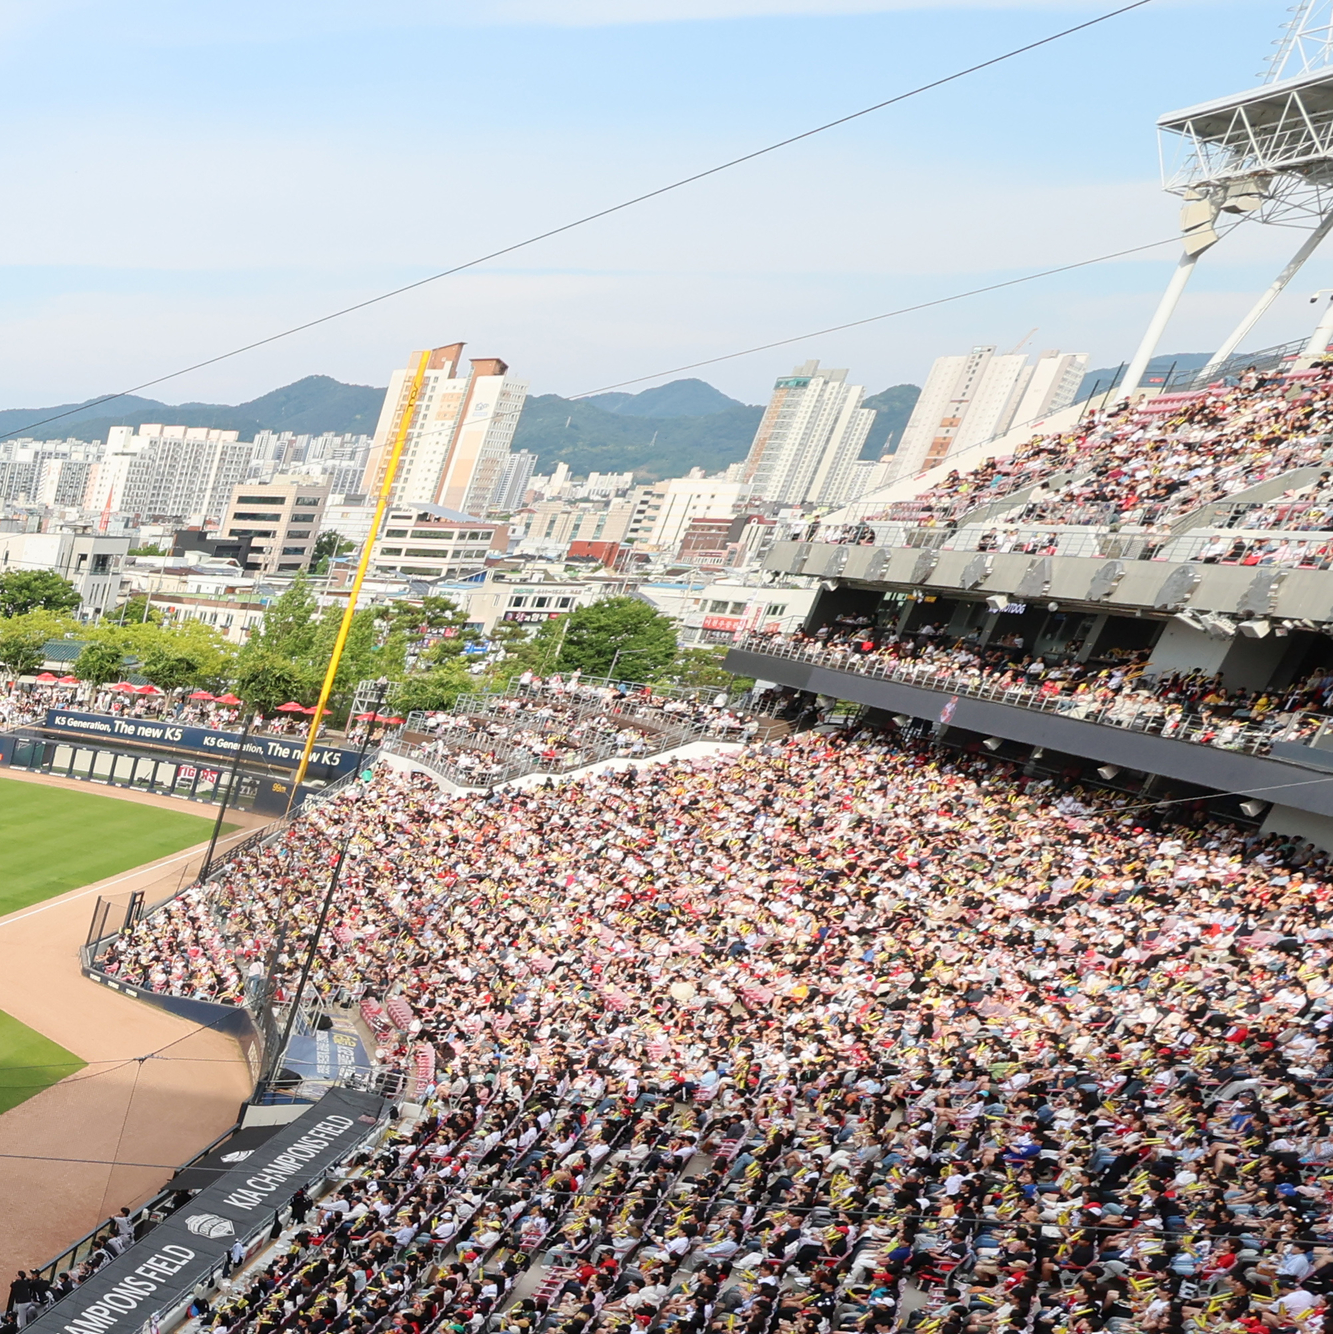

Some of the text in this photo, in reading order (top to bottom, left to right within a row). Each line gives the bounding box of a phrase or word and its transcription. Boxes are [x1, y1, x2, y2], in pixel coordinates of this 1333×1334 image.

[54, 715, 184, 742] K5 Generation, The new K5
[202, 735, 216, 747] K5
[266, 742, 292, 759] The
[320, 750, 342, 767] K5
[223, 1114, 355, 1211] KIA CHAMPIONS FIELD
[134, 1243, 197, 1290] FIELD
